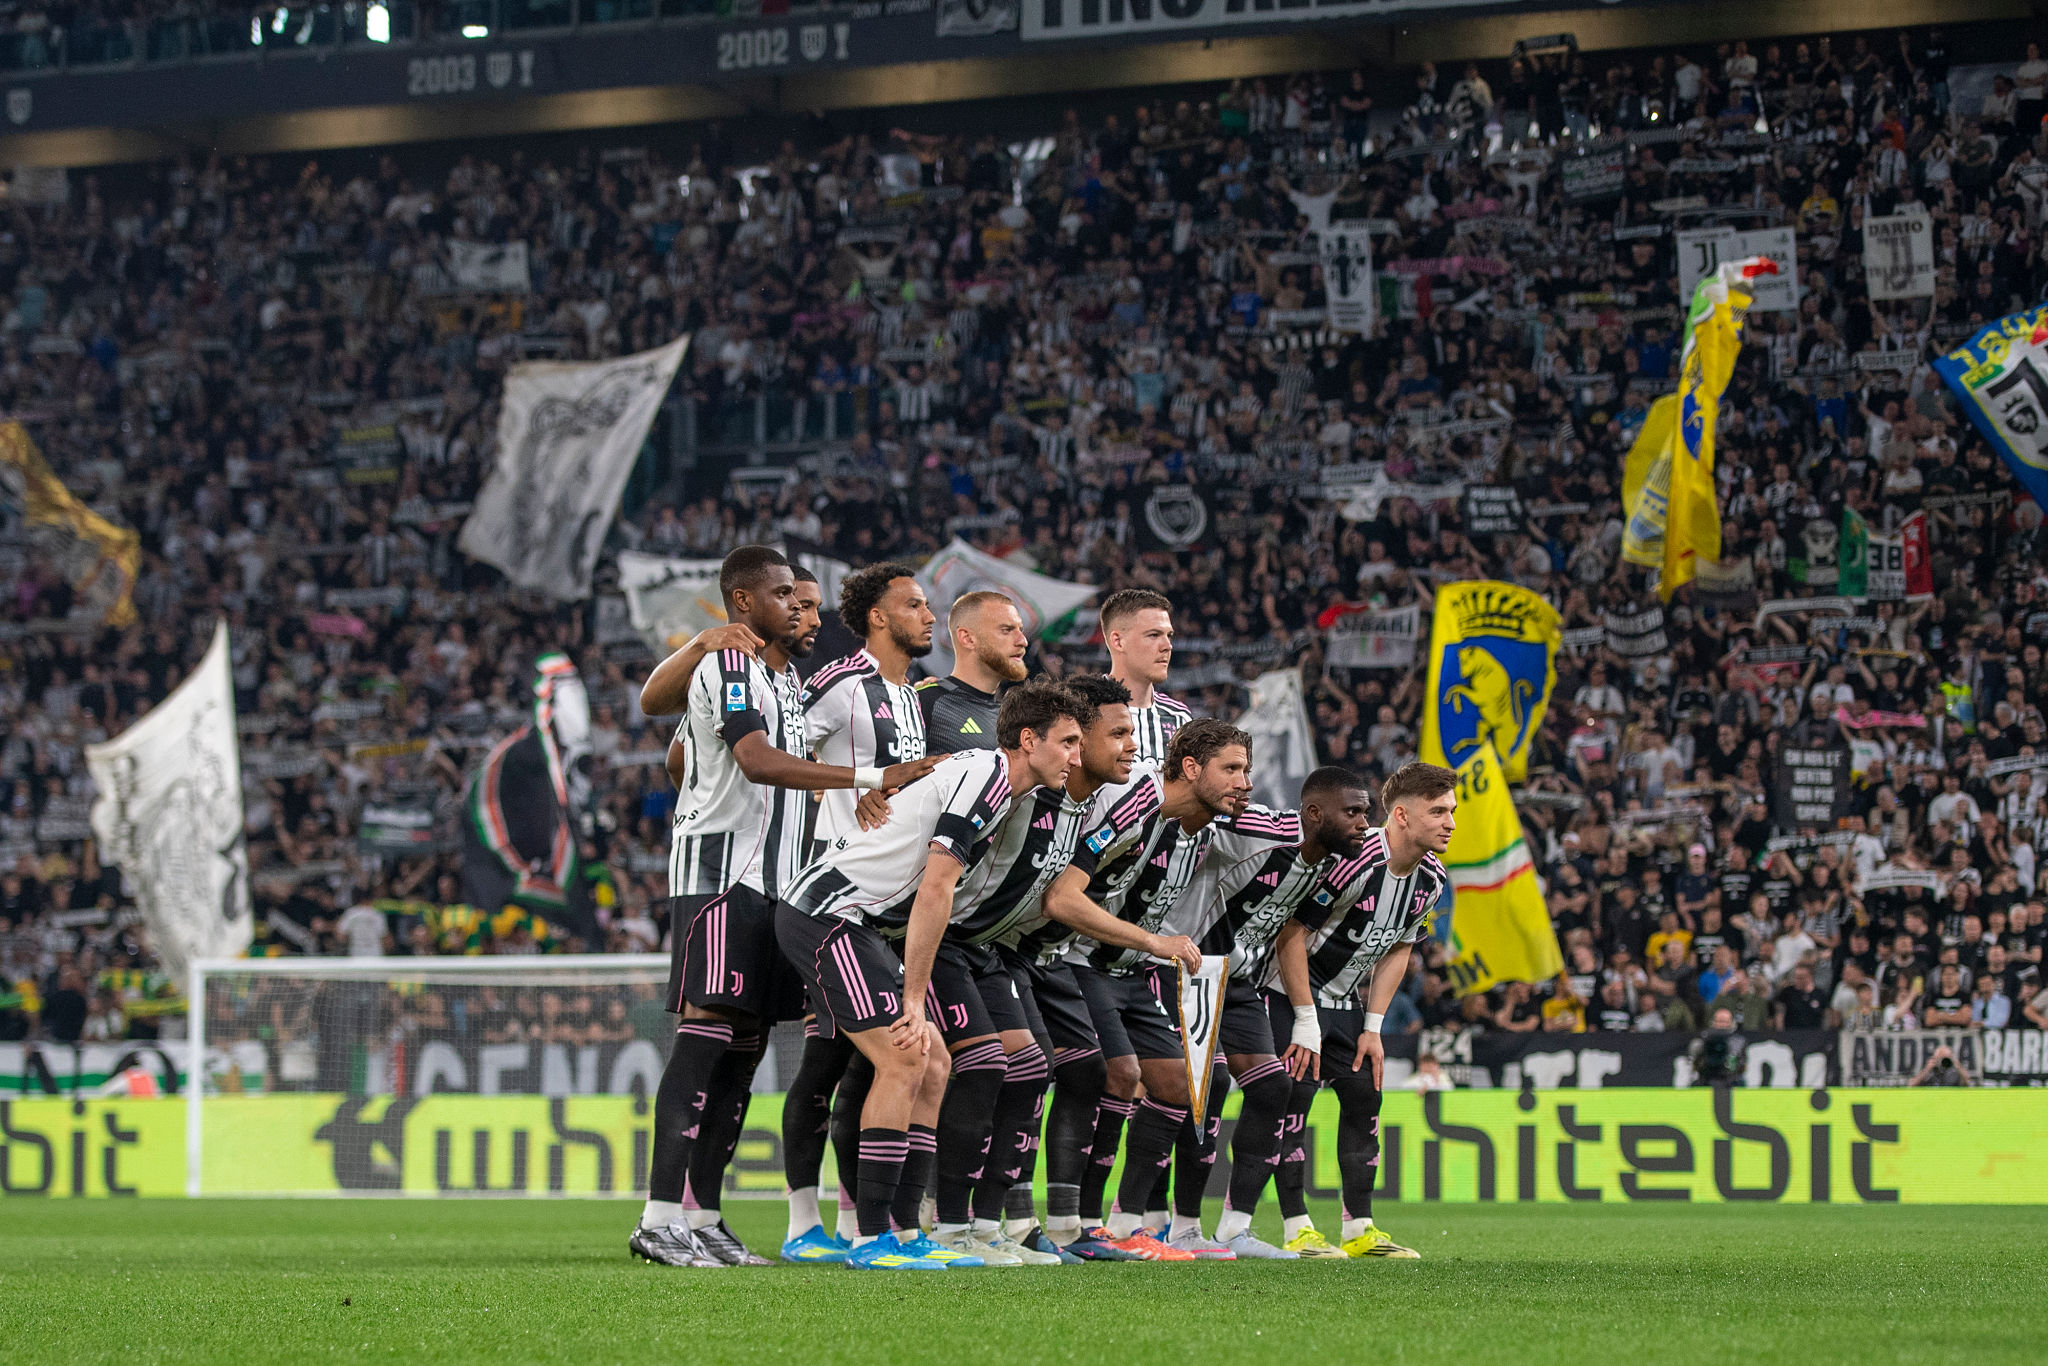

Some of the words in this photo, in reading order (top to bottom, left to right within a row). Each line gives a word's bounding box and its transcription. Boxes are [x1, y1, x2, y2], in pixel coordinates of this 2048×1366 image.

[718, 29, 790, 71] 2002
[408, 54, 477, 95] 2003
[1868, 221, 1924, 237] DARIO
[1984, 1029, 2048, 1074] BAR
